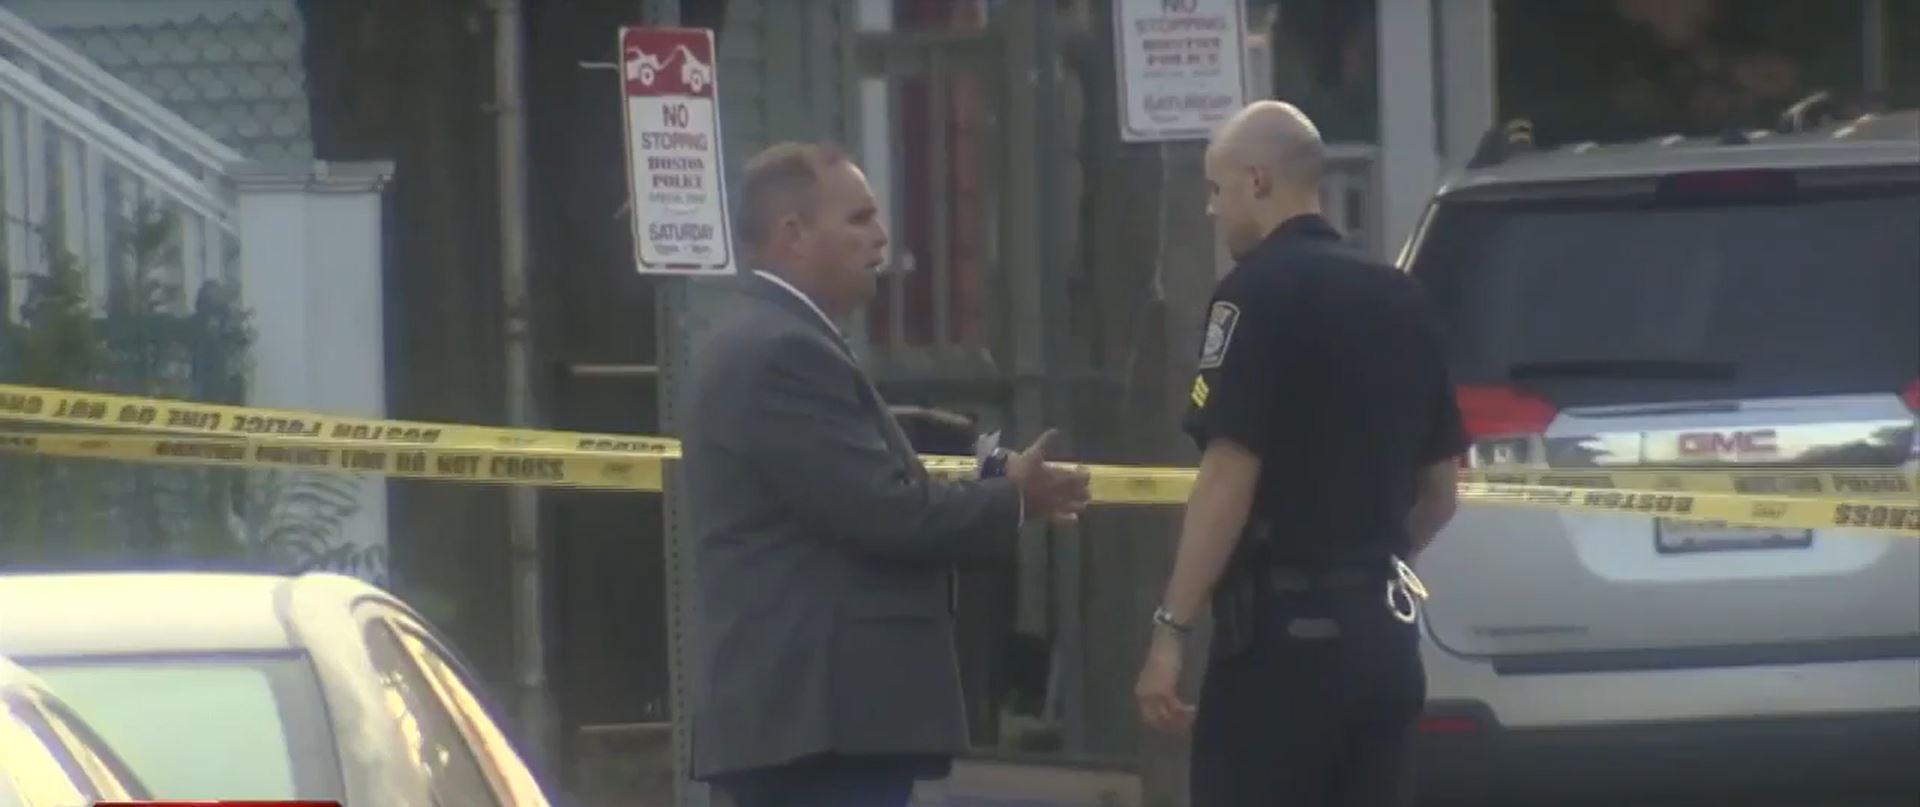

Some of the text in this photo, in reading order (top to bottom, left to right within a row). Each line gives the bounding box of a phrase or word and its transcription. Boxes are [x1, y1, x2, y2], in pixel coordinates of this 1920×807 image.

[662, 103, 689, 128] NO
[641, 131, 708, 151] STOPPING
[648, 155, 704, 171] BOSTON
[652, 174, 703, 189] POLICE
[648, 221, 714, 242] SATURDAY
[1678, 430, 1777, 456] GMC
[437, 454, 479, 477] NOT
[490, 456, 564, 481] CROSS
